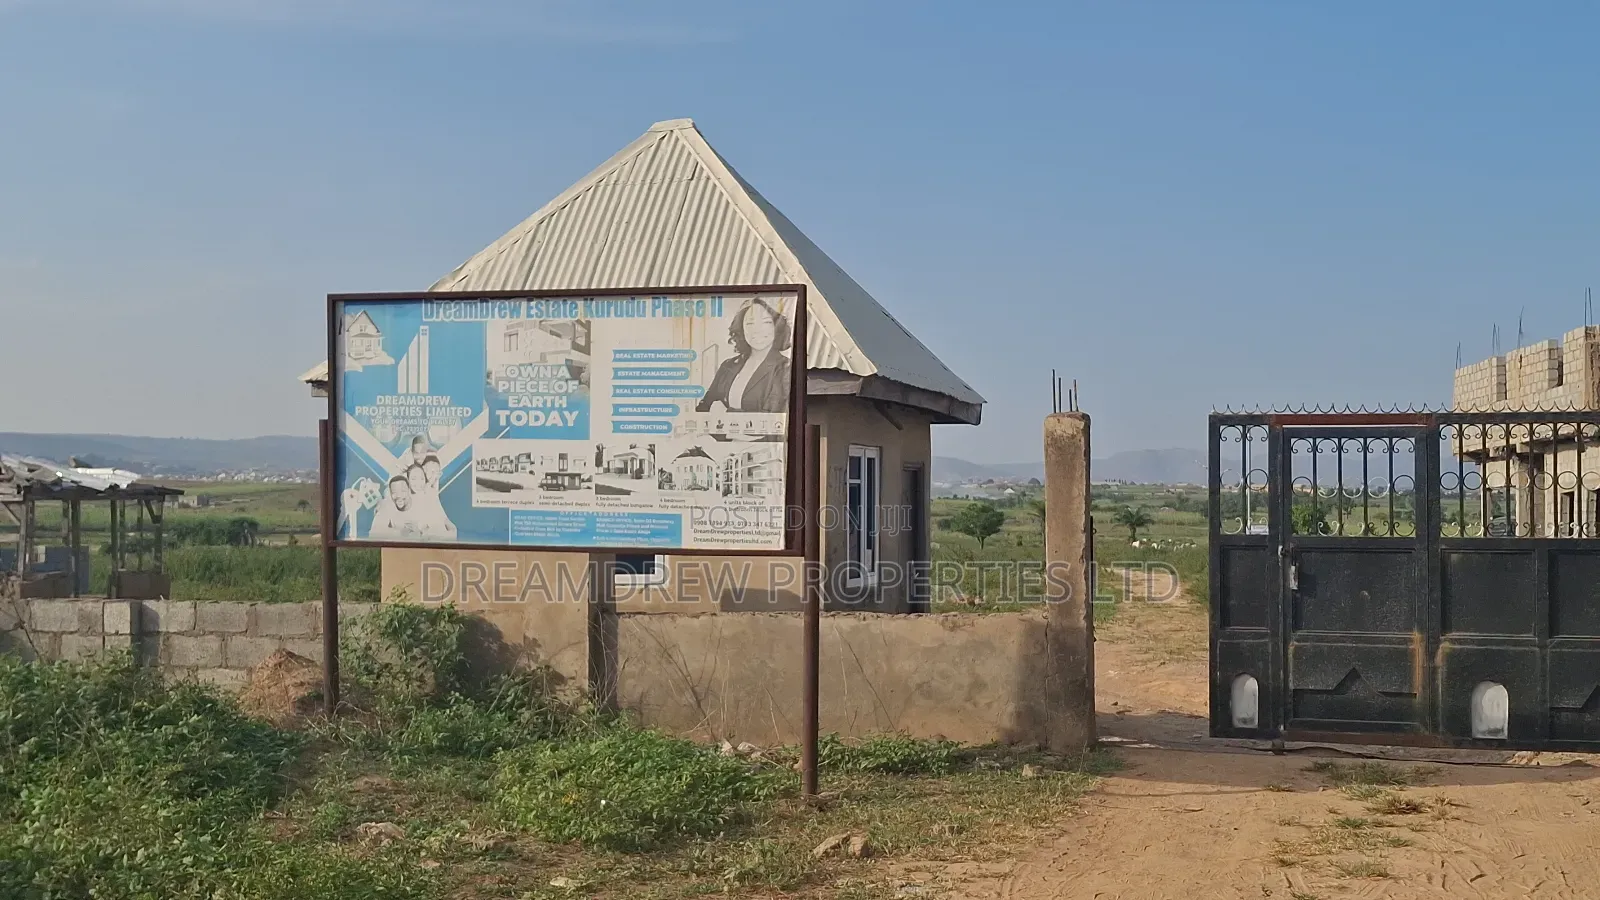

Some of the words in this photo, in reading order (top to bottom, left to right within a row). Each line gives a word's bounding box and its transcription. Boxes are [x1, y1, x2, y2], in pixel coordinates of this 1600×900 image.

[423, 298, 522, 321] DreamDrew
[526, 298, 579, 320] Estate
[583, 297, 646, 318] Kurudu
[652, 296, 706, 318] Phase
[710, 296, 722, 318] II
[506, 365, 552, 378] OWN
[558, 366, 572, 378] A
[498, 380, 548, 393] PIECE
[553, 380, 579, 393] OF
[376, 395, 450, 406] DREAMDREW
[508, 395, 567, 408] EARTH
[355, 406, 422, 417] PROPERTIES
[426, 406, 472, 417] LIMITED
[496, 410, 579, 427] TODAY
